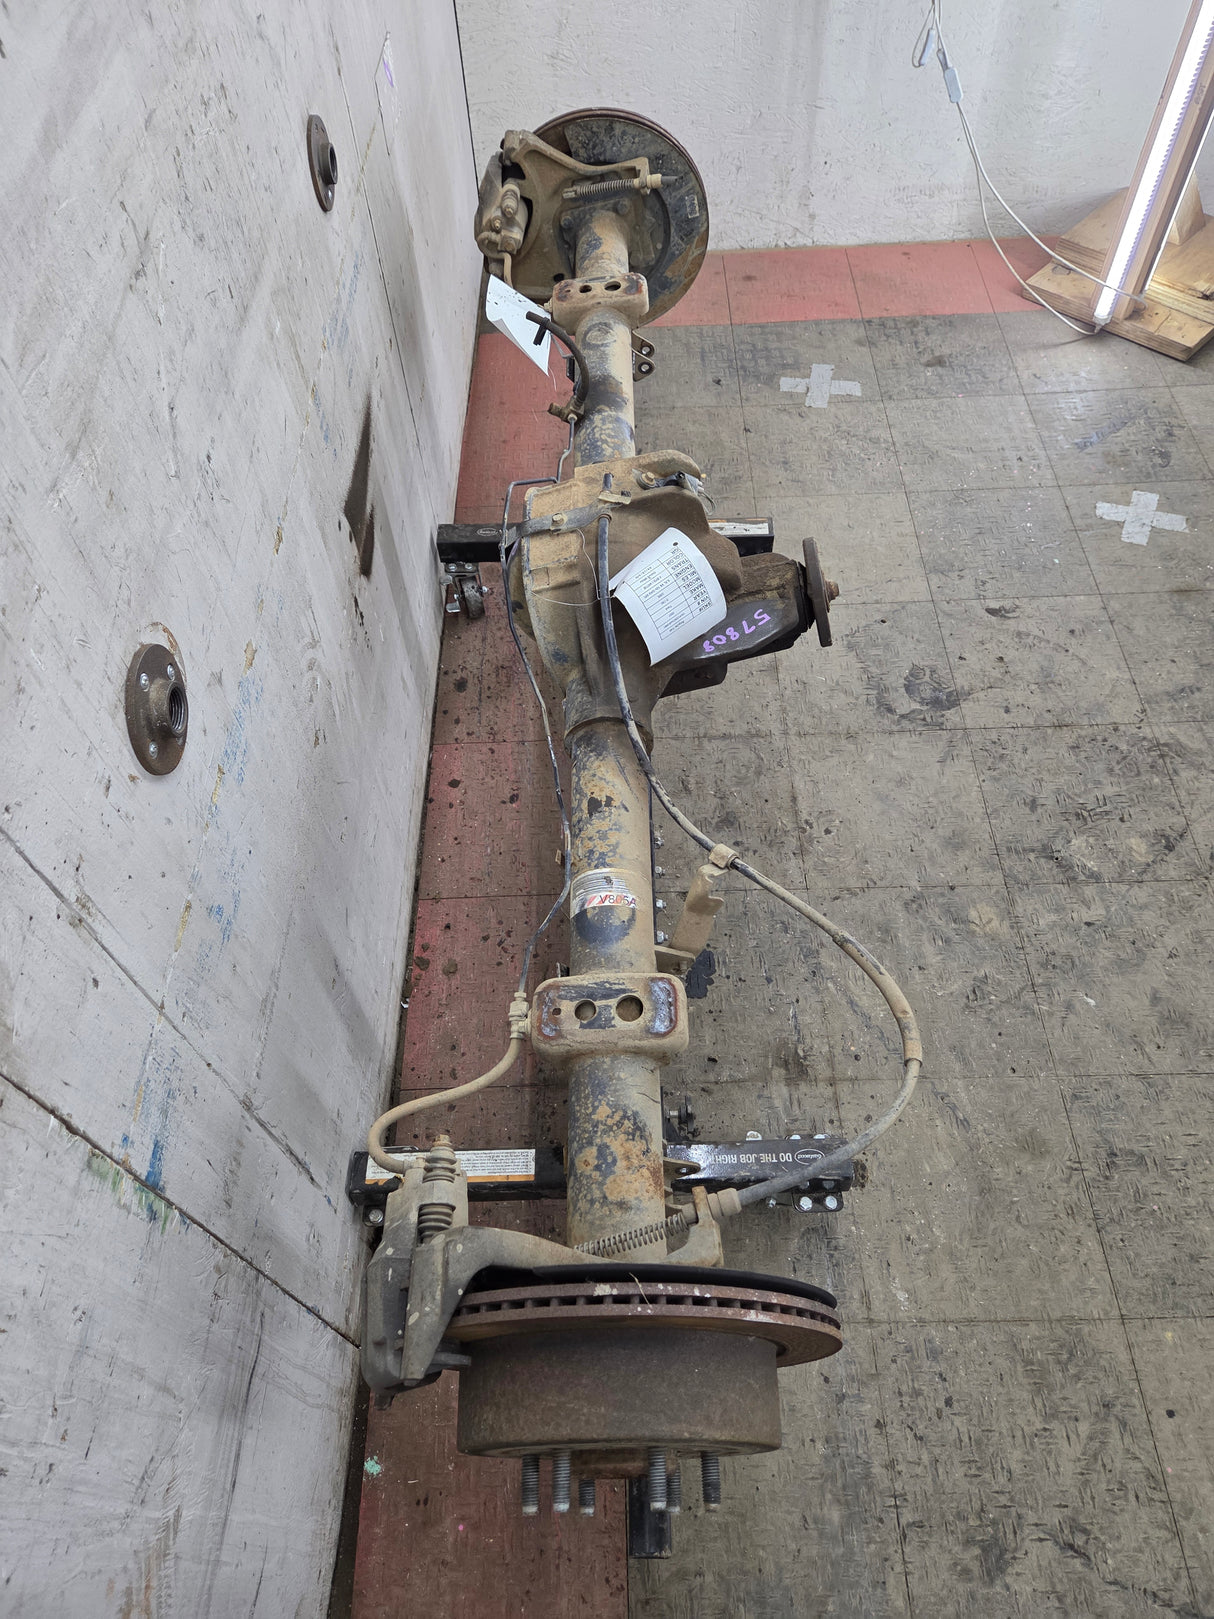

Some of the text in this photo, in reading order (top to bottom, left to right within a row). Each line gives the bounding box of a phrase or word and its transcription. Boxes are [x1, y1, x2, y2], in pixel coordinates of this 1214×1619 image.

[665, 551, 683, 566] COLOR
[670, 557, 688, 571] TRANS
[673, 563, 693, 578] ENGINE
[680, 569, 696, 582] MILES
[682, 575, 701, 590] MODEL
[688, 582, 704, 594] MAKE
[691, 588, 706, 600] YEAR
[740, 1153, 758, 1164] JOB
[760, 1153, 778, 1163] THE
[780, 1152, 793, 1162] DO
